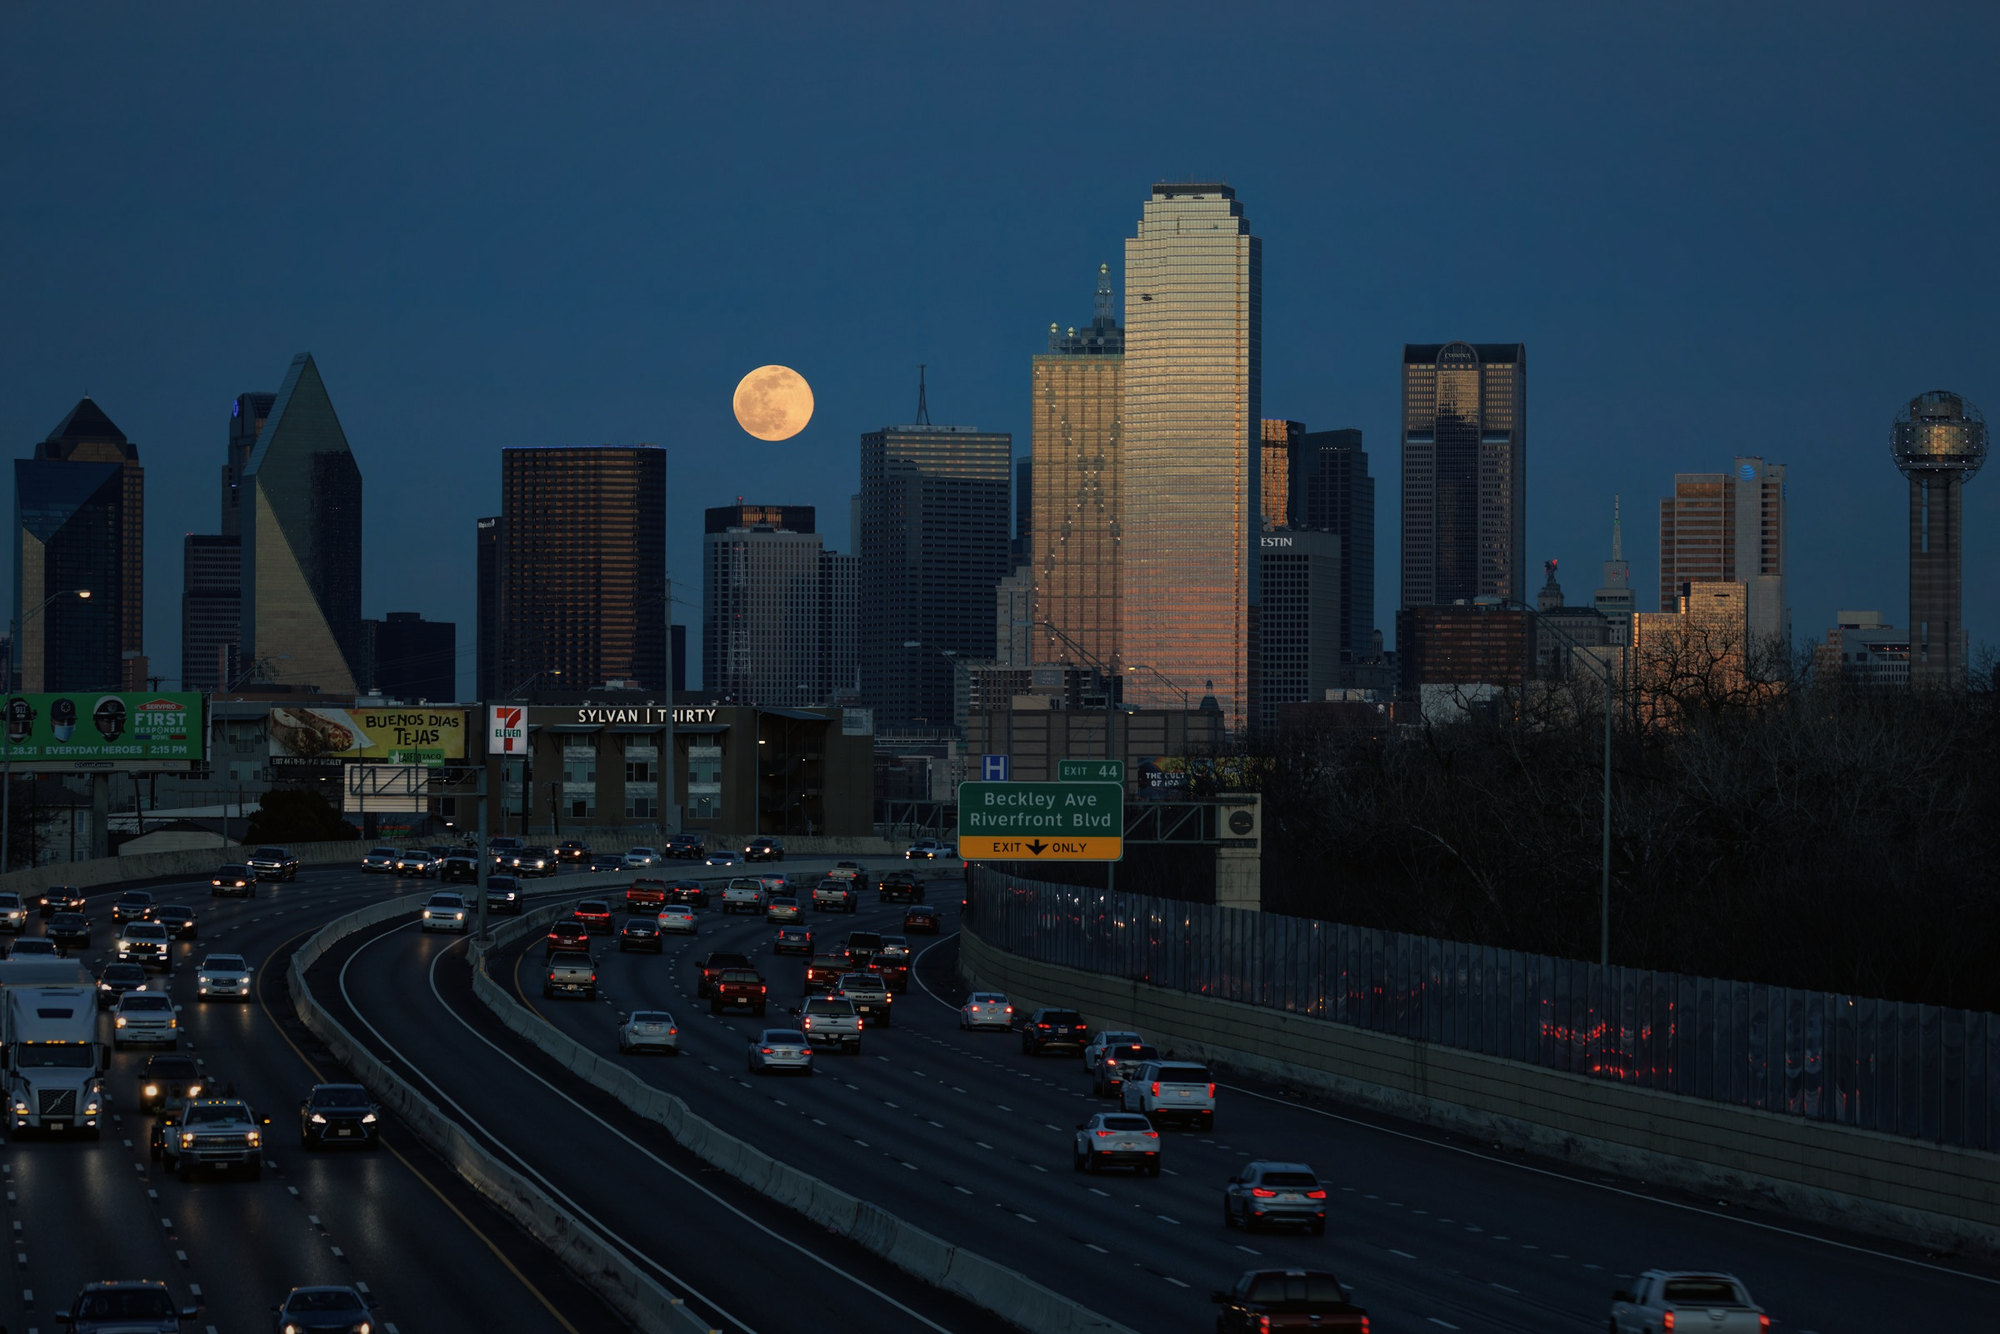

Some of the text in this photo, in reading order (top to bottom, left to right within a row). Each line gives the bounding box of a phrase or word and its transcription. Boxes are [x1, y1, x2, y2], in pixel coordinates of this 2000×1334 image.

[1260, 536, 1292, 547] ESTIN
[134, 713, 187, 726] F1RST
[366, 714, 459, 728] BUENOS DIAS
[578, 709, 638, 723] SYLVAN
[134, 726, 187, 734] RESPONDER
[496, 707, 521, 751] 7
[393, 727, 440, 746] TEJAS
[45, 746, 99, 755] EVERYDAY
[101, 745, 143, 755] HEROES
[150, 745, 170, 754] 2:15
[172, 745, 187, 754] PM
[985, 756, 1004, 780] H
[1064, 765, 1118, 777] EXIT 44
[1151, 779, 1163, 787] OF
[984, 792, 1097, 810] Beckley Ave
[970, 812, 1111, 827] Riverfront Blvd
[993, 842, 1087, 852] EXIT ONLY
